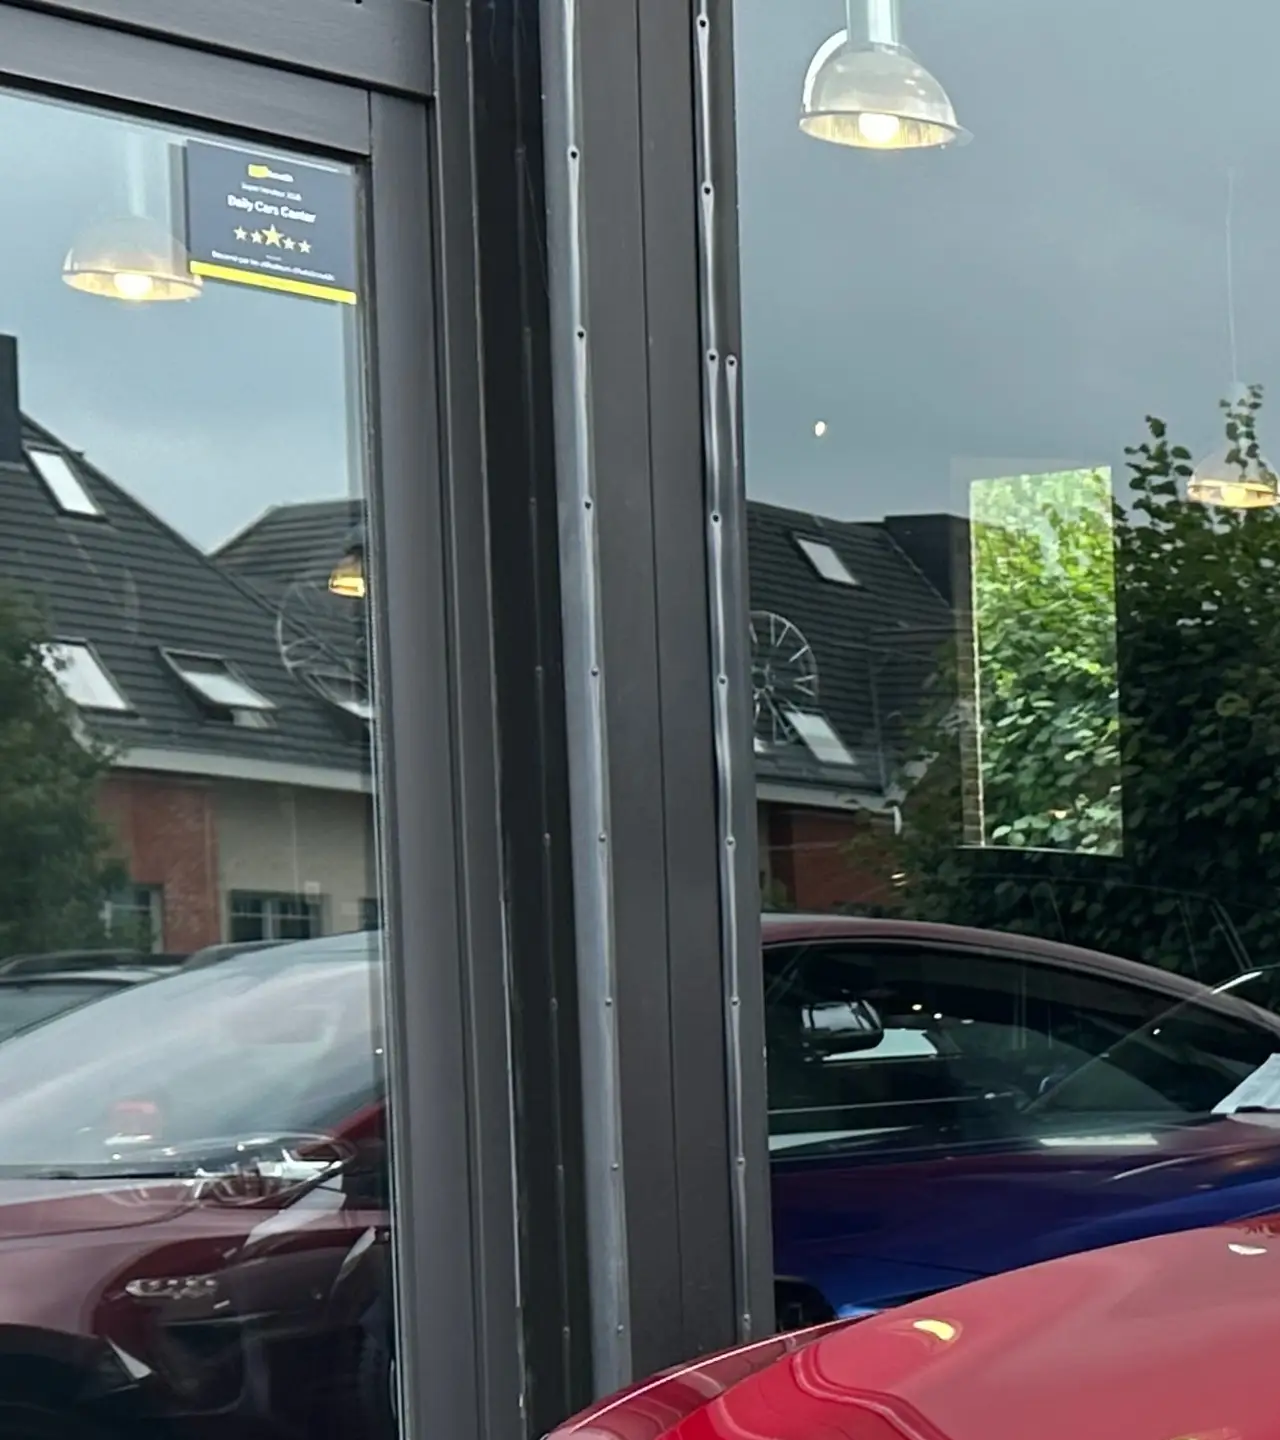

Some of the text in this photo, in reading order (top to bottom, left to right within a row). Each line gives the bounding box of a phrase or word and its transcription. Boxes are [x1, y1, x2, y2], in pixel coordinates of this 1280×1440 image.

[227, 194, 317, 223] Daily Cars Center
